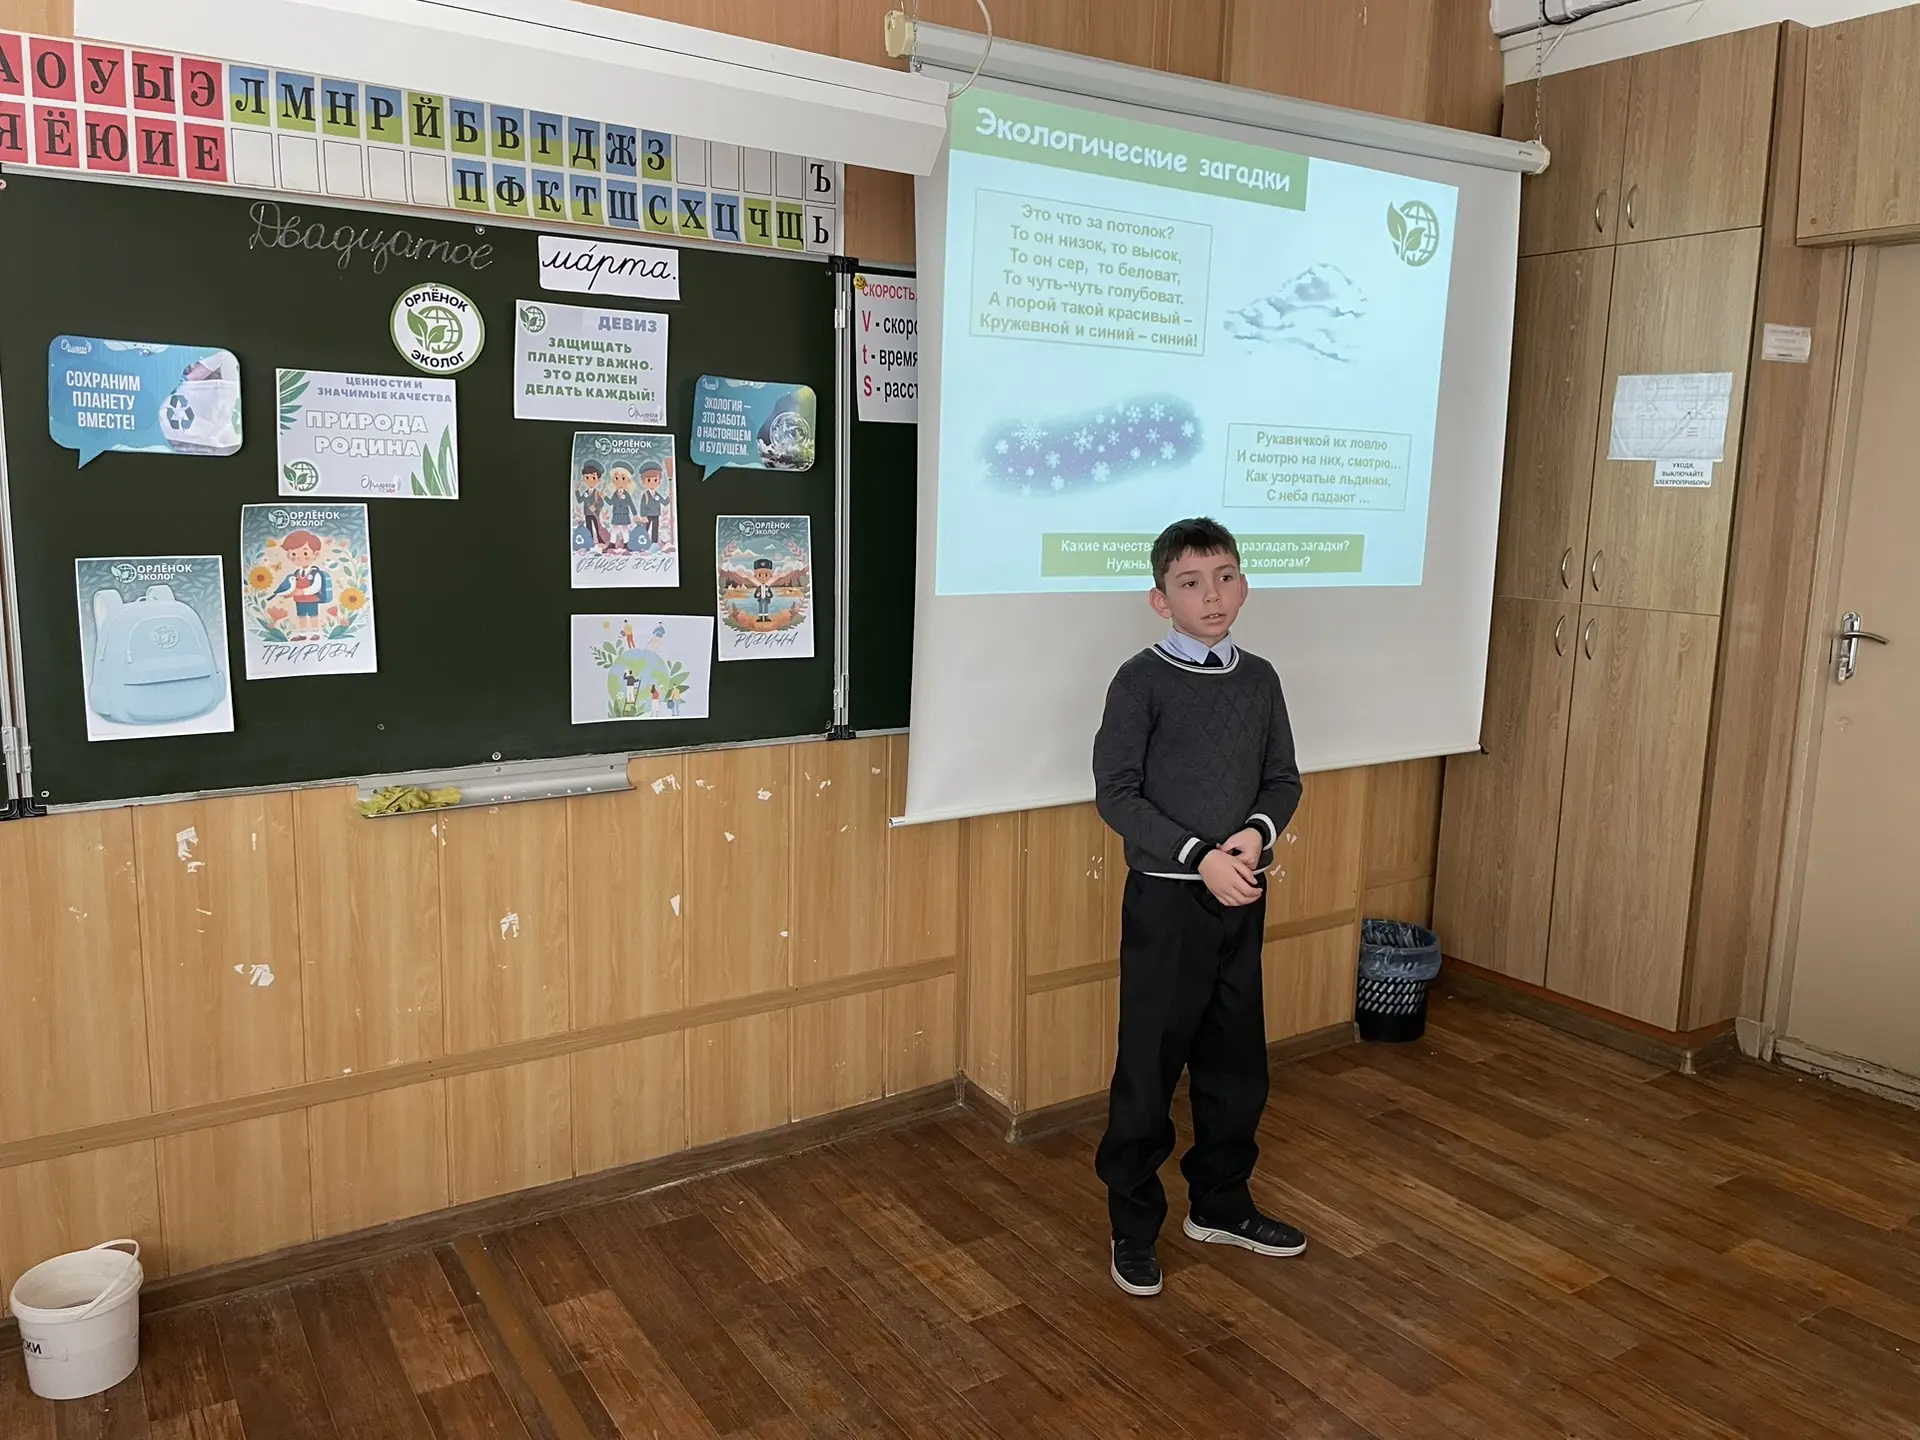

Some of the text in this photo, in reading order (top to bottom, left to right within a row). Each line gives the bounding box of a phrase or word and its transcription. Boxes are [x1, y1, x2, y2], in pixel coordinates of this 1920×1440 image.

[36, 51, 67, 89] О
[87, 57, 118, 94] У
[134, 64, 175, 101] Ы
[190, 71, 216, 107] Э
[235, 77, 266, 114] Л
[281, 83, 315, 120] М
[326, 90, 356, 126] Н
[370, 96, 394, 131] Р
[413, 97, 441, 139] Й
[455, 109, 478, 143] Б
[498, 116, 520, 149] В
[537, 121, 557, 155] Г
[573, 128, 597, 169] Д
[606, 132, 637, 167] Ж
[647, 139, 665, 170] З
[810, 163, 832, 194] Ъ
[975, 107, 1290, 192] Экологические загадки
[43, 109, 72, 157] Ё
[86, 122, 128, 161] Ю
[143, 128, 175, 167] И
[195, 135, 220, 171] Е
[458, 169, 485, 204] П
[496, 175, 526, 207] Ф
[538, 180, 561, 212] К
[575, 184, 597, 216] Т
[608, 191, 638, 221] Ш
[649, 194, 668, 226] С
[682, 198, 704, 230] Х
[714, 203, 739, 239] Ц
[748, 208, 768, 239] Ч
[776, 210, 804, 244] Щ
[813, 216, 830, 245] Ь
[1022, 204, 1175, 240] Это что за потолок?
[250, 200, 494, 274] Двадцатое
[1010, 224, 1181, 264] То он низок, то высок,
[1010, 247, 1181, 285] То он сер, то беловат,
[1003, 269, 1184, 305] То чуть-чуть голубоват.
[405, 289, 468, 312] ОРЛЁНОК
[989, 291, 1001, 306] А
[1006, 294, 1056, 312] порой
[1061, 299, 1103, 317] такой
[1108, 304, 1180, 325] красивый
[598, 316, 657, 332] ДЕВИЗ
[862, 310, 871, 332] V
[980, 312, 1069, 335] Кружевной
[1075, 325, 1085, 336] и
[1089, 326, 1135, 341] синий
[1151, 331, 1197, 348] синий!
[549, 337, 632, 353] ЗАЩИЩАТЬ
[863, 344, 867, 364] t
[411, 350, 464, 368] ЭКОЛОГ
[528, 352, 653, 371] ПЛАНЕТУ ВАЖНО.
[66, 370, 140, 391] СОХРАНИМ
[346, 377, 423, 389] ЦЕННОСТИ И
[544, 369, 637, 385] ЭТО ДОЛЖЕН
[864, 375, 872, 397] S
[73, 391, 135, 410] ПЛАНЕТУ
[317, 387, 452, 403] ЗНАЧИМЫЕ КАЧЕСТВА
[525, 384, 655, 402] ДЕЛАТЬ КАЖДЫЙ!
[704, 397, 743, 412] ЭКОЛОГИЯ
[78, 411, 135, 430] ВМЕСТЕ!
[306, 410, 428, 435] ПРИРОДА
[702, 412, 746, 427] ЭТО ЗАБОТА
[697, 426, 751, 441] О НАСТОЯЩЕМ
[1257, 430, 1388, 450] Рукавичкой их ловлю
[315, 436, 421, 458] РОДИНА
[699, 441, 705, 452] И
[1237, 450, 1246, 463] И
[1249, 453, 1298, 467] смотрю
[1302, 455, 1317, 465] на
[1320, 456, 1344, 468] них,
[1246, 469, 1391, 487] Как узорчатые льдинки,
[1267, 489, 1276, 501] С
[1279, 489, 1308, 502] неба
[1311, 493, 1356, 504] падают
[290, 510, 340, 520] ОРЛЁНОК
[290, 519, 325, 527] ЭКОЛОГ
[755, 520, 791, 530] ОРЛЁНОК
[1061, 540, 1100, 552] Какие
[1242, 541, 1299, 554] разгадать
[1301, 540, 1349, 553] загадки?
[137, 563, 193, 574] ОРЛЁНОК
[1251, 557, 1311, 569] экологам?
[137, 573, 175, 581] ЭКОЛОГ
[734, 632, 798, 649] РОДИНА
[262, 642, 360, 665] ПРИРОДА
